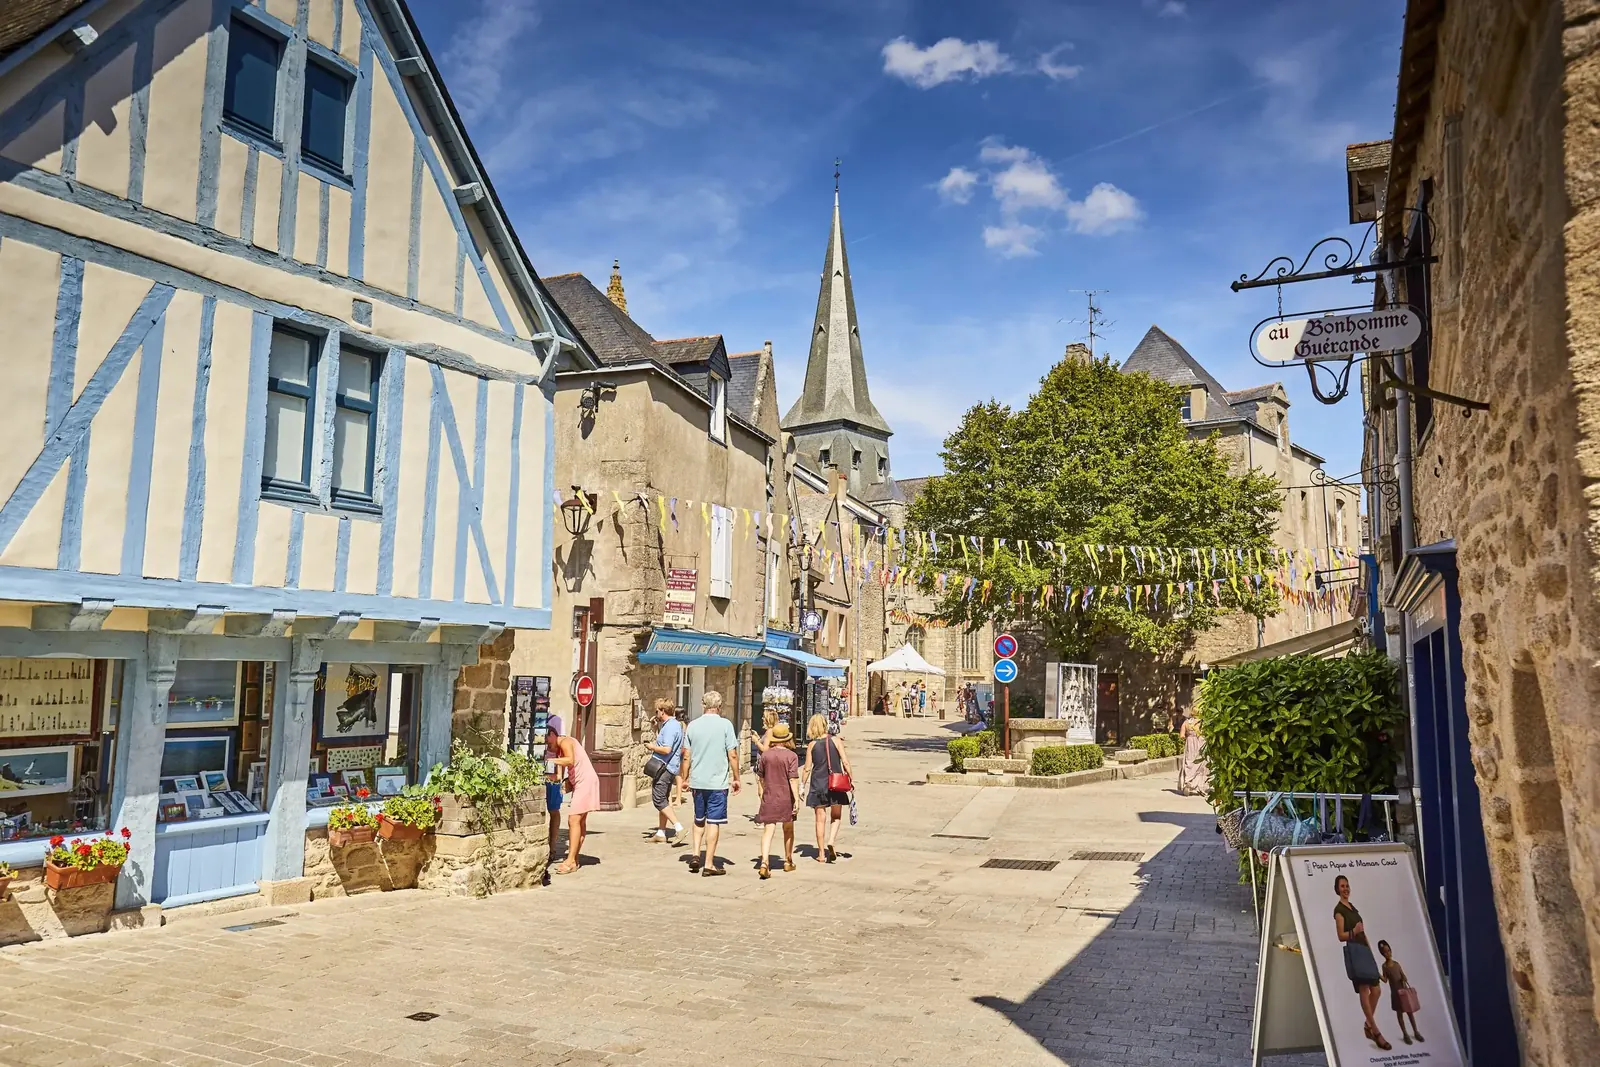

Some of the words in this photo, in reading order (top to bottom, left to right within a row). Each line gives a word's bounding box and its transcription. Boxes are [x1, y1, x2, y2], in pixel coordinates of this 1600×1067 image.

[1268, 326, 1289, 341] au
[1306, 313, 1408, 337] Bonhomme
[1295, 334, 1380, 357] Guérande
[1312, 861, 1328, 872] Papa
[1329, 860, 1347, 872] Pique
[1349, 860, 1355, 868] et
[1355, 859, 1380, 867] Maman
[1381, 858, 1398, 866] Coud
